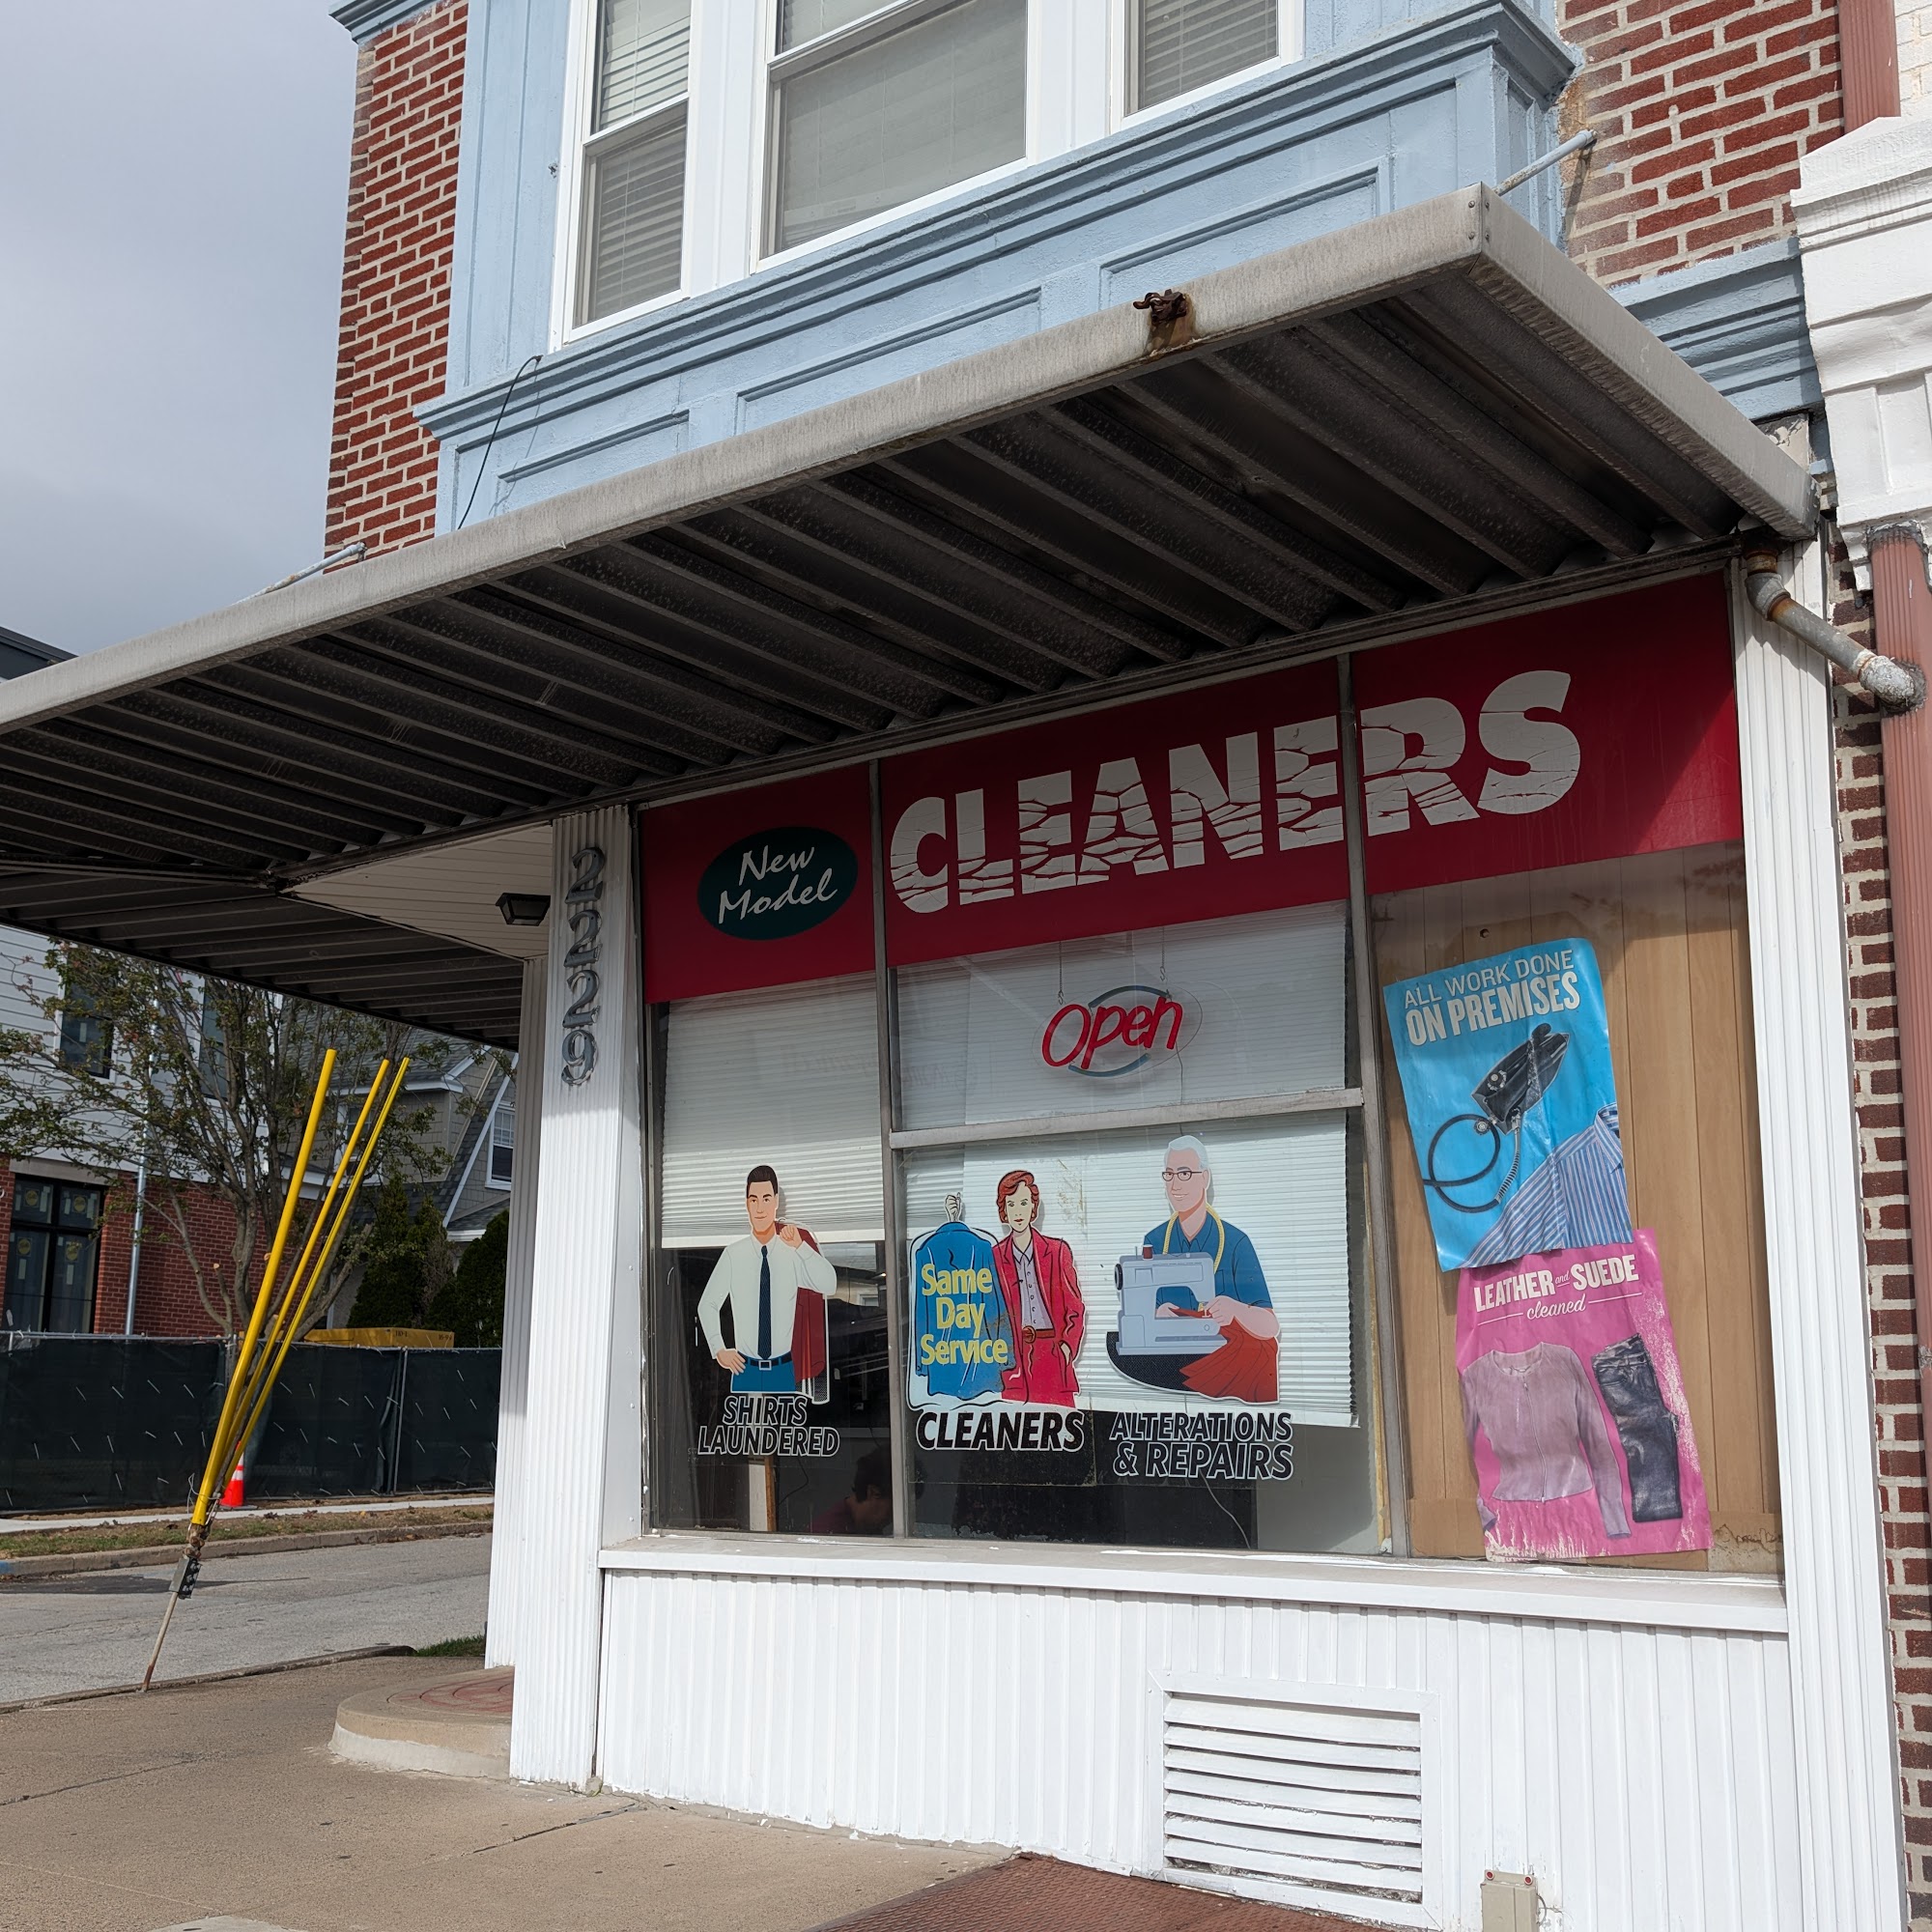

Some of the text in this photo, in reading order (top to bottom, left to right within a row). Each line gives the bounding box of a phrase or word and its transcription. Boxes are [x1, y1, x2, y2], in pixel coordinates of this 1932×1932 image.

[890, 669, 1581, 914] CLEANERS
[738, 844, 815, 887] New
[718, 867, 838, 924] Model
[561, 846, 606, 1086] 2229
[1405, 949, 1575, 1009] ALL WORK DONE
[1406, 971, 1580, 1046] ON PREMISES
[1041, 996, 1183, 1069] Open
[921, 1263, 993, 1296] Same
[1473, 1254, 1640, 1312] LEATHER and SUEDE
[935, 1296, 985, 1339] Day
[1526, 1293, 1586, 1320] cleaned
[921, 1333, 1009, 1366] Service
[722, 1395, 808, 1427] SHIRTS
[917, 1410, 1085, 1451] CLEANERS
[1109, 1411, 1293, 1442] ALTERATIONS
[697, 1425, 840, 1457] LAUNDERED
[1113, 1441, 1294, 1481] & REPAIRS
